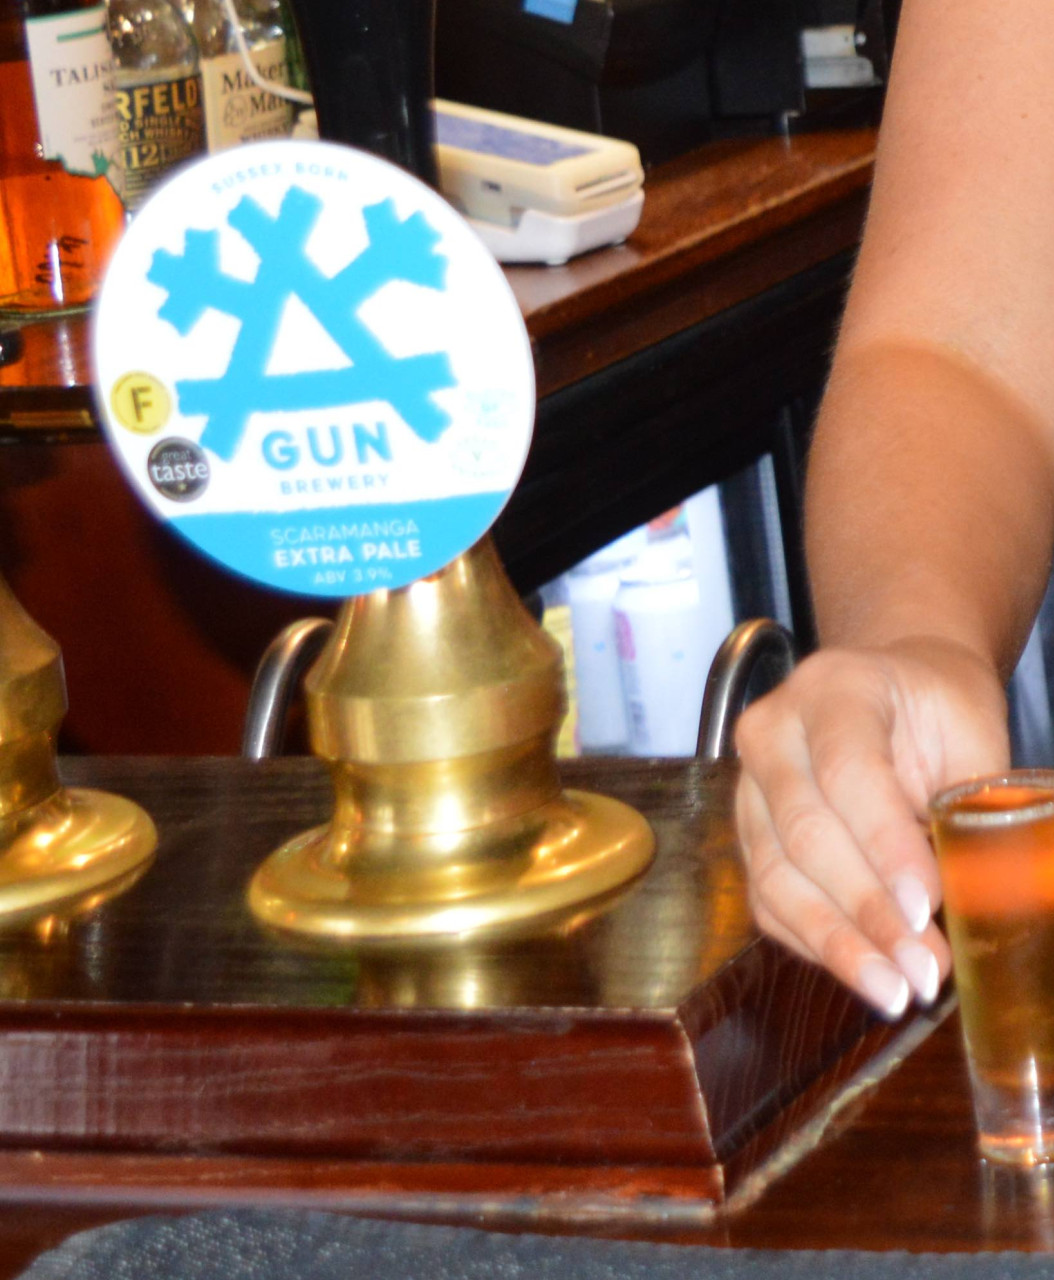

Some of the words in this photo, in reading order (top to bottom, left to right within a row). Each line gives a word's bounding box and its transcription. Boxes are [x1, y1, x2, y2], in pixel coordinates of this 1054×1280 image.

[132, 386, 153, 422] F
[161, 450, 193, 463] great
[261, 421, 393, 471] GUN
[152, 462, 208, 483] taste
[280, 474, 389, 496] BREWERY
[271, 519, 420, 546] SCARAMANGA
[273, 545, 354, 569] EXTRA
[362, 539, 422, 561] PALE
[314, 570, 346, 585] ABV
